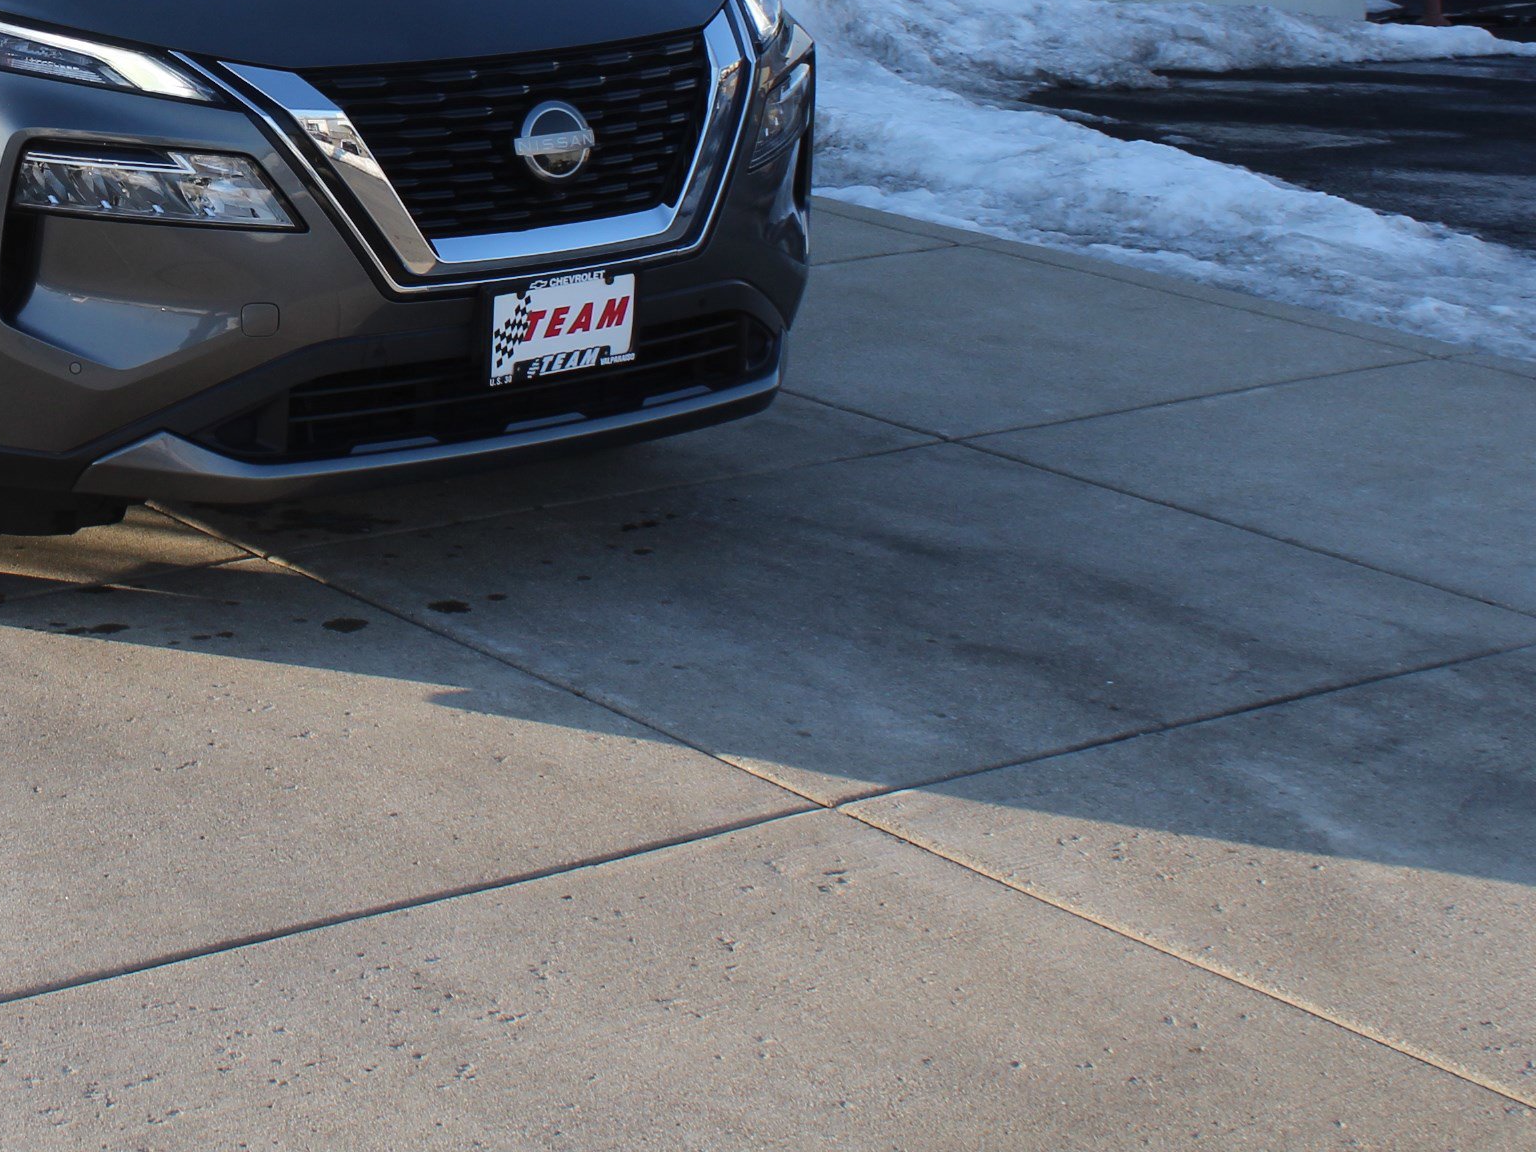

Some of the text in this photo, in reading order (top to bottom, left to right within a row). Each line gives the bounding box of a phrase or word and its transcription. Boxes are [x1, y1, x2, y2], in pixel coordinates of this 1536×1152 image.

[517, 131, 594, 152] NISSAN
[549, 270, 605, 288] CHEVROLET
[522, 296, 630, 342] TEAM
[539, 347, 600, 374] TEAM
[490, 377, 503, 387] U.S.
